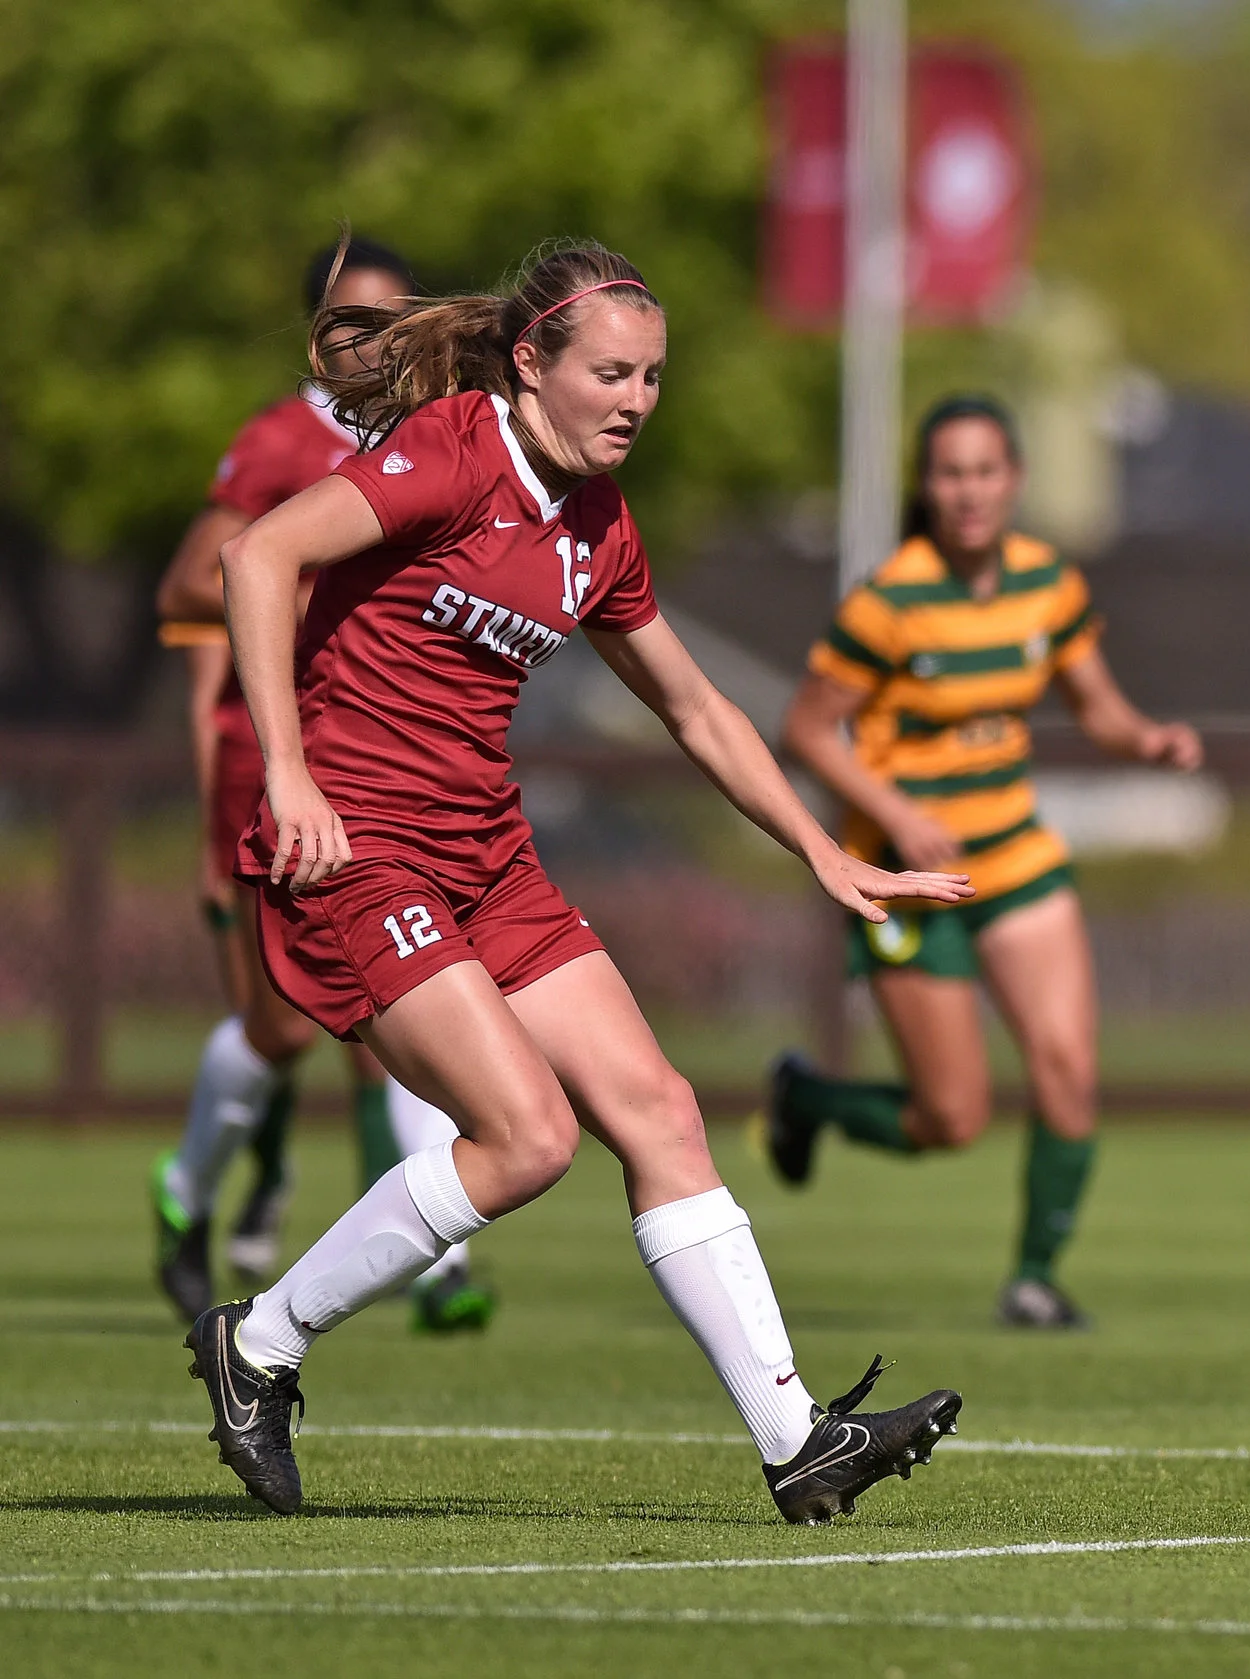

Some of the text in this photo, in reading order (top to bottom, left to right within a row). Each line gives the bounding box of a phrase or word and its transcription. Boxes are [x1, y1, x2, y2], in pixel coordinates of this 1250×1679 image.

[555, 536, 592, 621] 12
[421, 583, 569, 670] STANFO
[383, 904, 443, 960] 12
